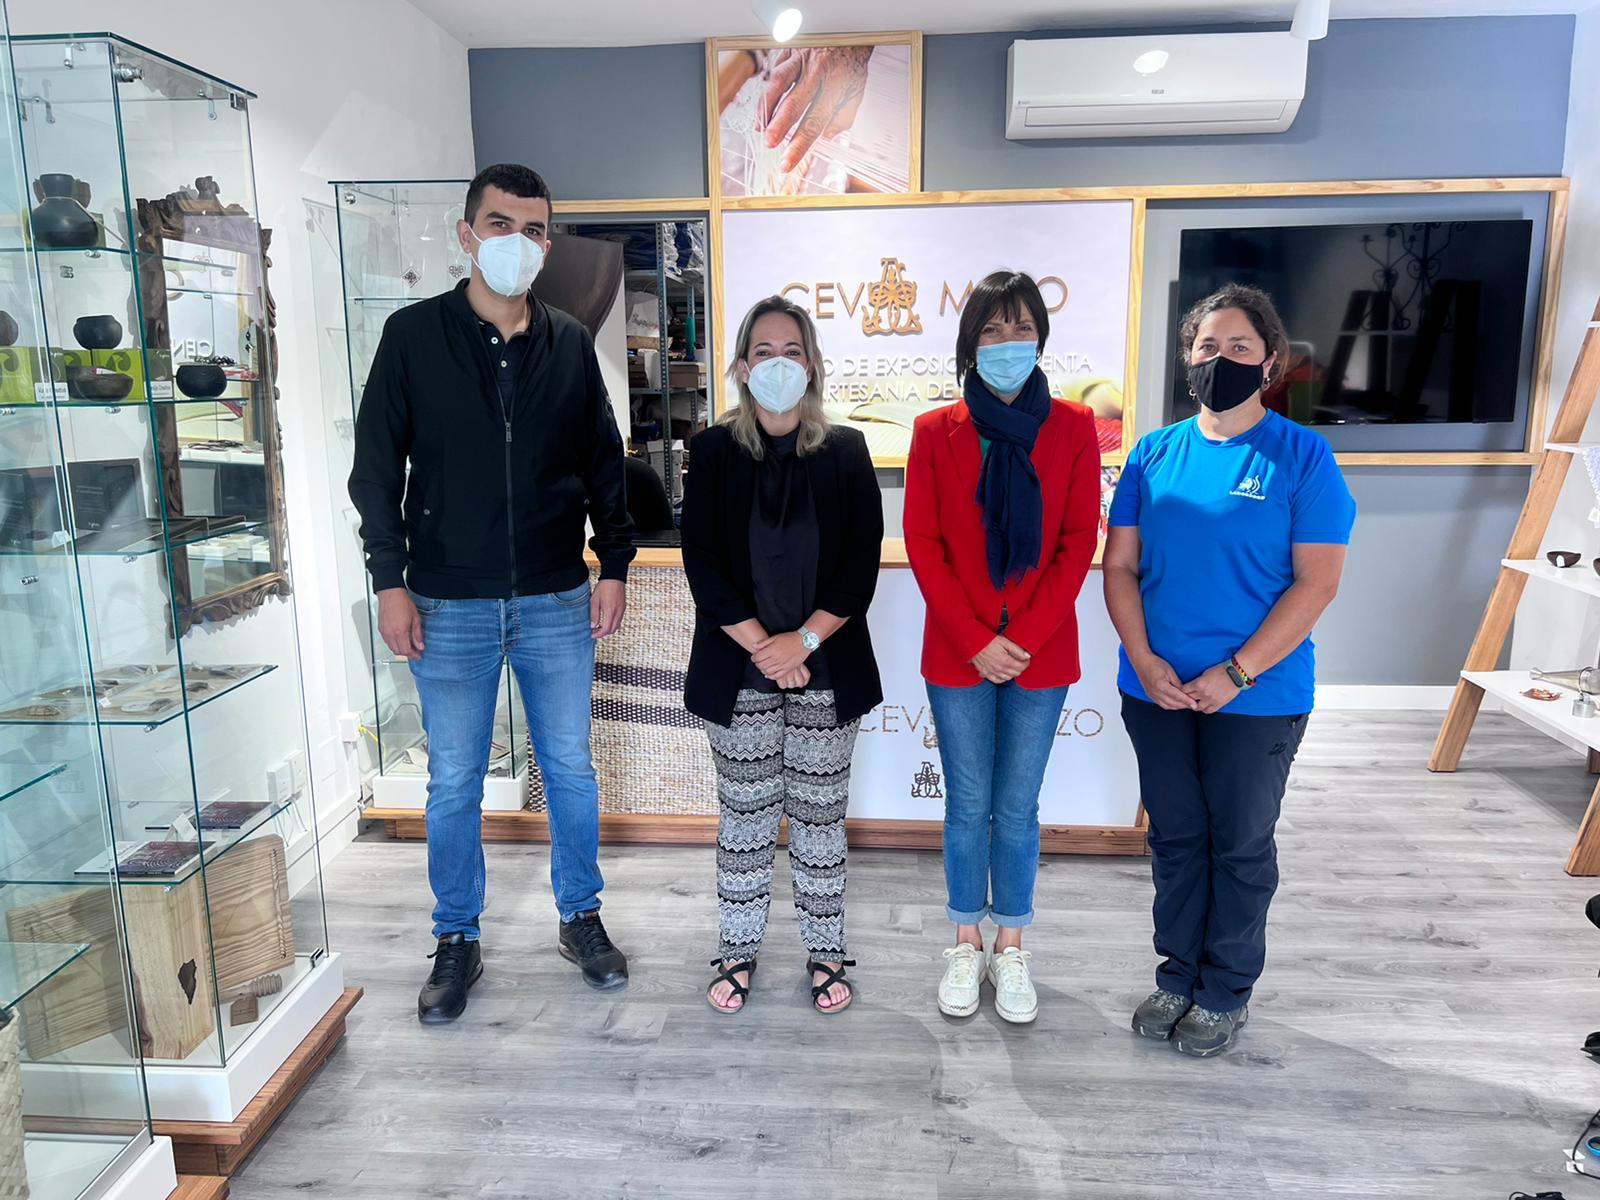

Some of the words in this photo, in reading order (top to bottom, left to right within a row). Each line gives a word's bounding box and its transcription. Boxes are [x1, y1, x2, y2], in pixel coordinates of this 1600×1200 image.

[841, 355, 869, 377] DE
[874, 354, 957, 377] EXPOSIC
[1041, 352, 1095, 374] ENTA
[927, 381, 954, 401] DE
[1056, 708, 1105, 738] ZO
